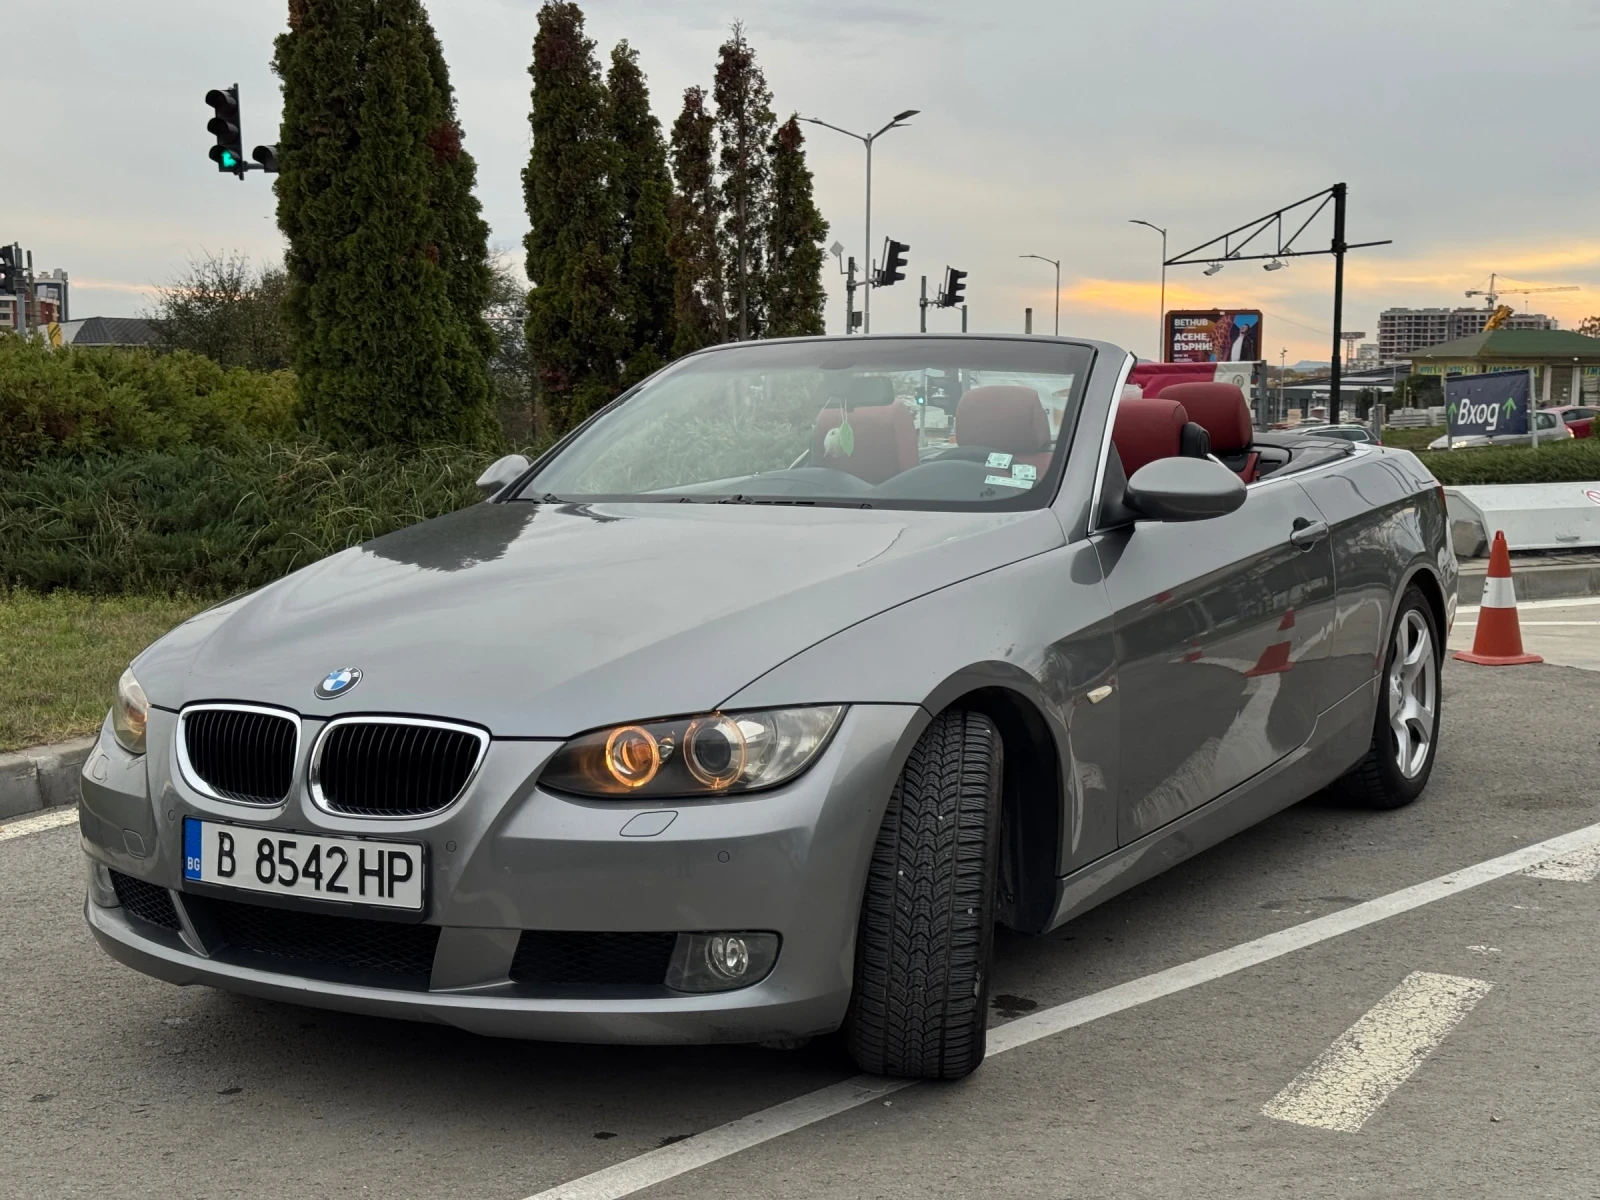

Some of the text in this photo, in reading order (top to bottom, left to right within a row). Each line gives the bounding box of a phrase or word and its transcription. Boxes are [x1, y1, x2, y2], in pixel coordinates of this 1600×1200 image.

[1174, 343, 1212, 351] ВЪРНИ!
[187, 856, 201, 872] BG
[217, 831, 413, 898] B 8542 HP
